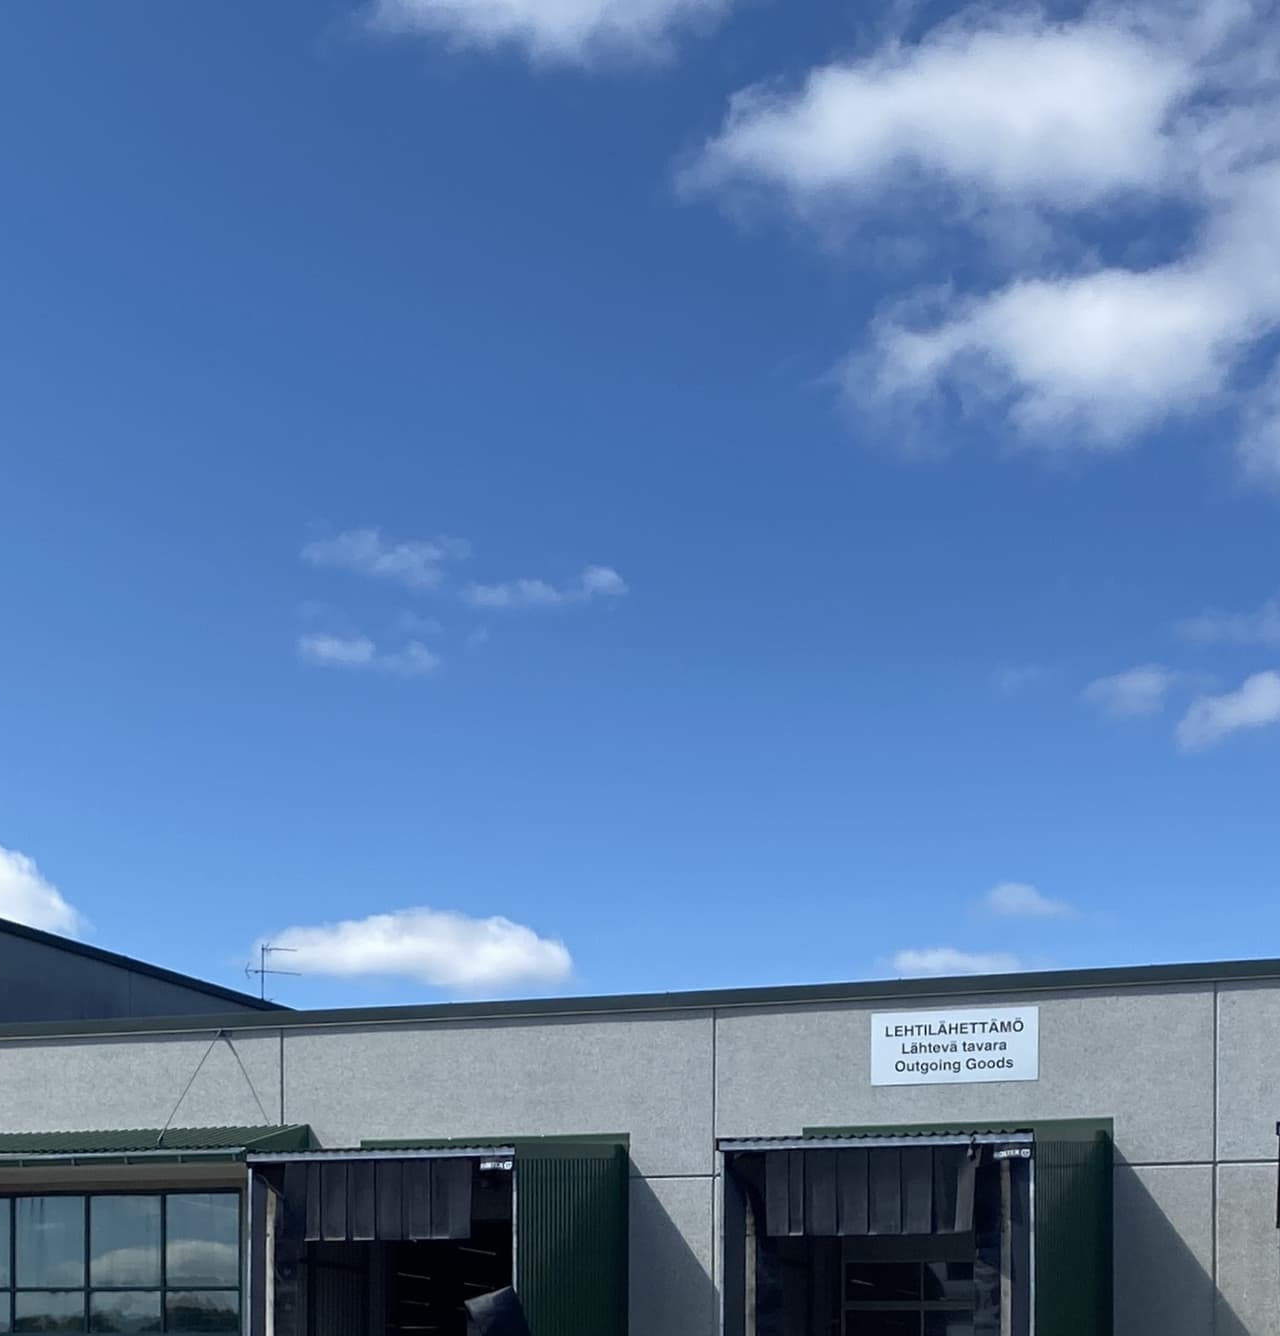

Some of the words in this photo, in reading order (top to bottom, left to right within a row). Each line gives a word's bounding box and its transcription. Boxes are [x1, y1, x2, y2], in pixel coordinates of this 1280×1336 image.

[885, 1017, 1024, 1037] LEHTILÄHETTÄMÖ
[901, 1041, 958, 1054] Lähtevä
[962, 1040, 1007, 1053] tavara
[894, 1058, 961, 1074] Outgoing
[966, 1056, 1014, 1071] Goods
